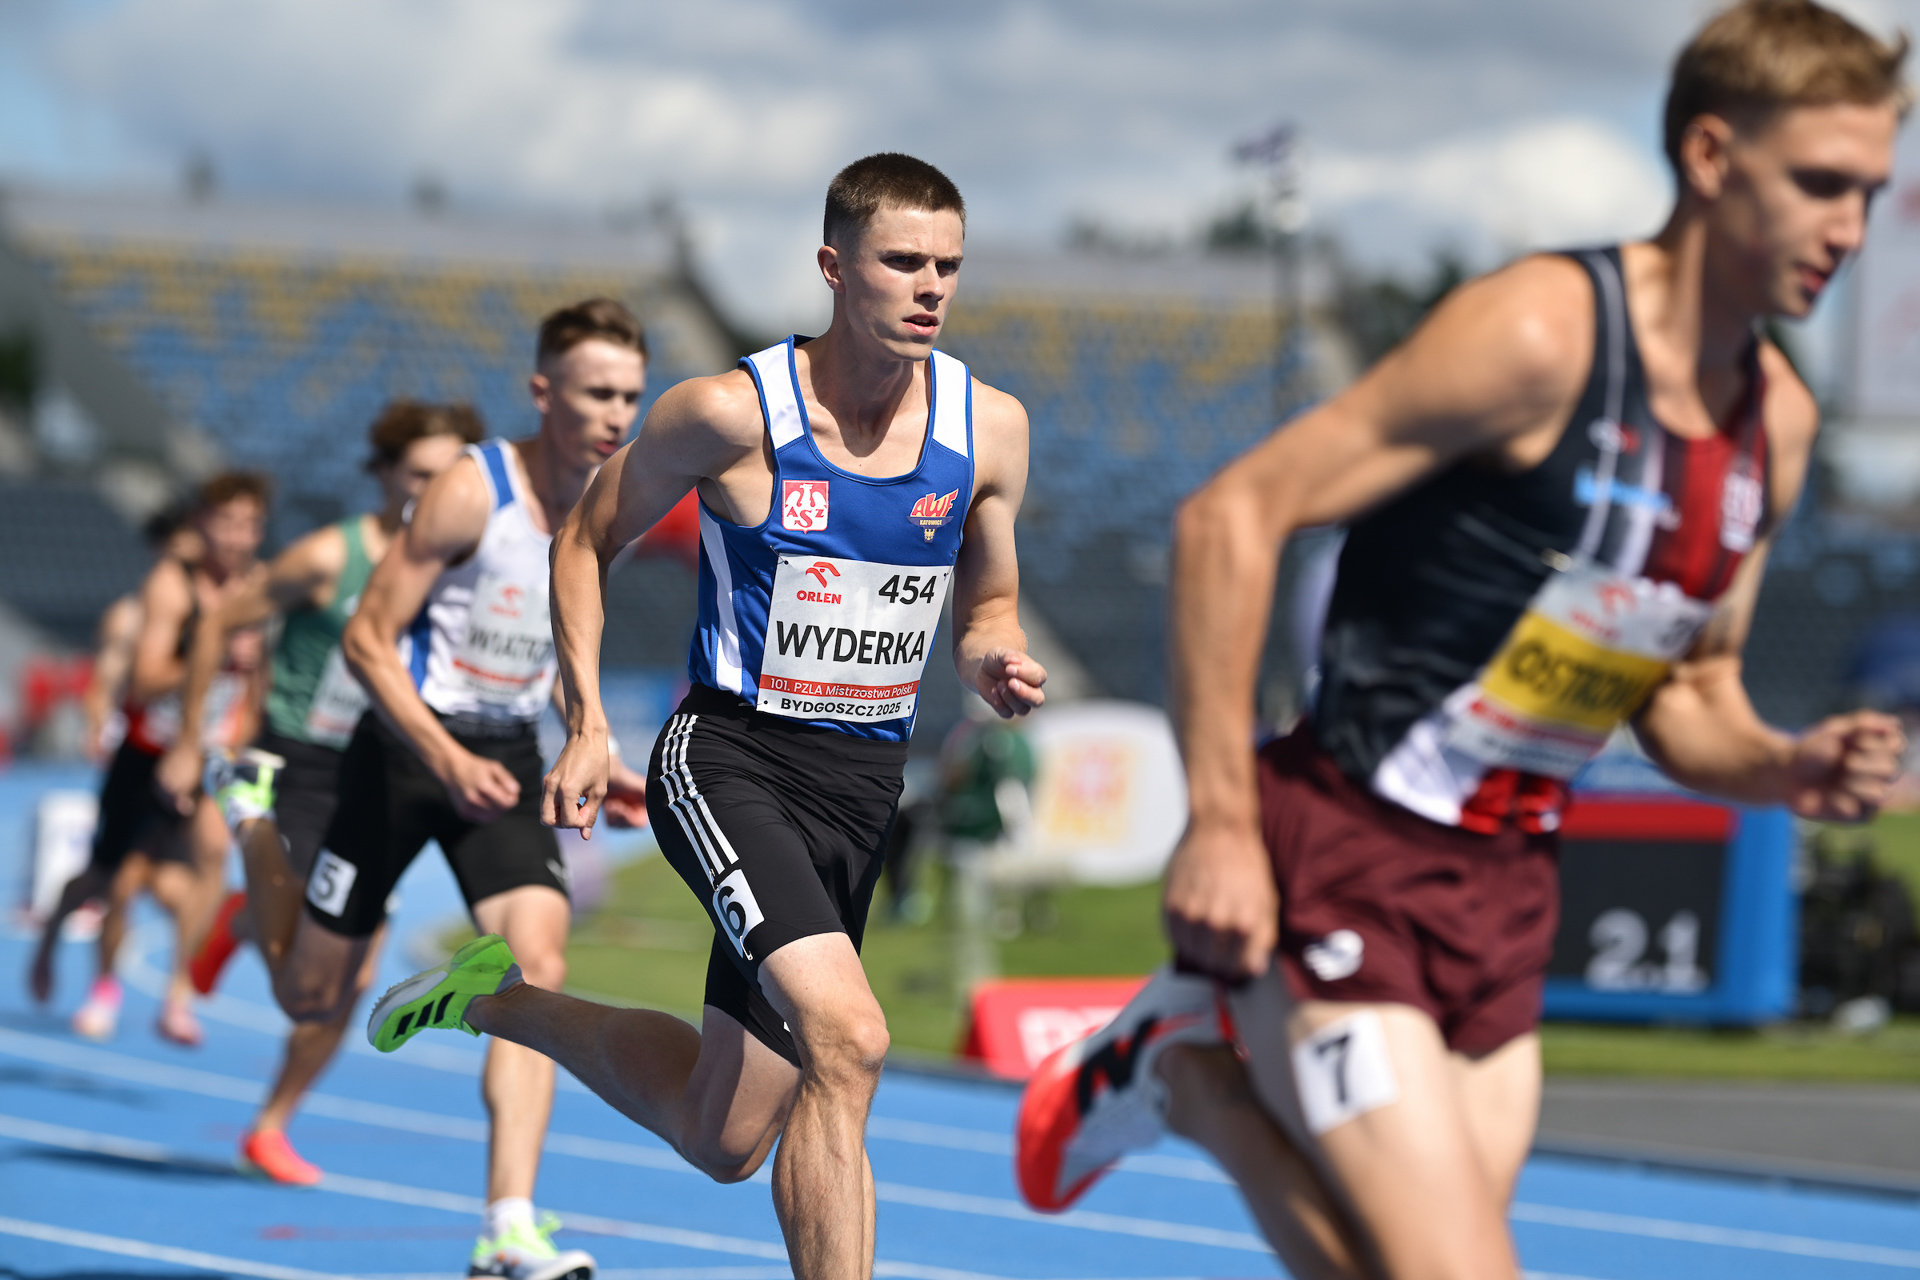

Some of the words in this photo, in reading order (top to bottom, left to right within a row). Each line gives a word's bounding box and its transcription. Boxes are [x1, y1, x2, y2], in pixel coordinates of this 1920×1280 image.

[910, 488, 959, 517] AWF
[796, 590, 842, 605] ORLEN
[878, 574, 937, 605] 454
[776, 620, 926, 665] WYDERKA
[770, 677, 790, 692] 101.
[794, 681, 823, 696] PZLA
[825, 684, 891, 699] Mistrzostwa
[891, 682, 914, 697] Polski
[780, 697, 875, 717] BYDGOSZCZ
[875, 702, 901, 716] 2025
[313, 862, 339, 902] 5
[717, 885, 747, 940] 6
[1315, 1032, 1352, 1104] 7
